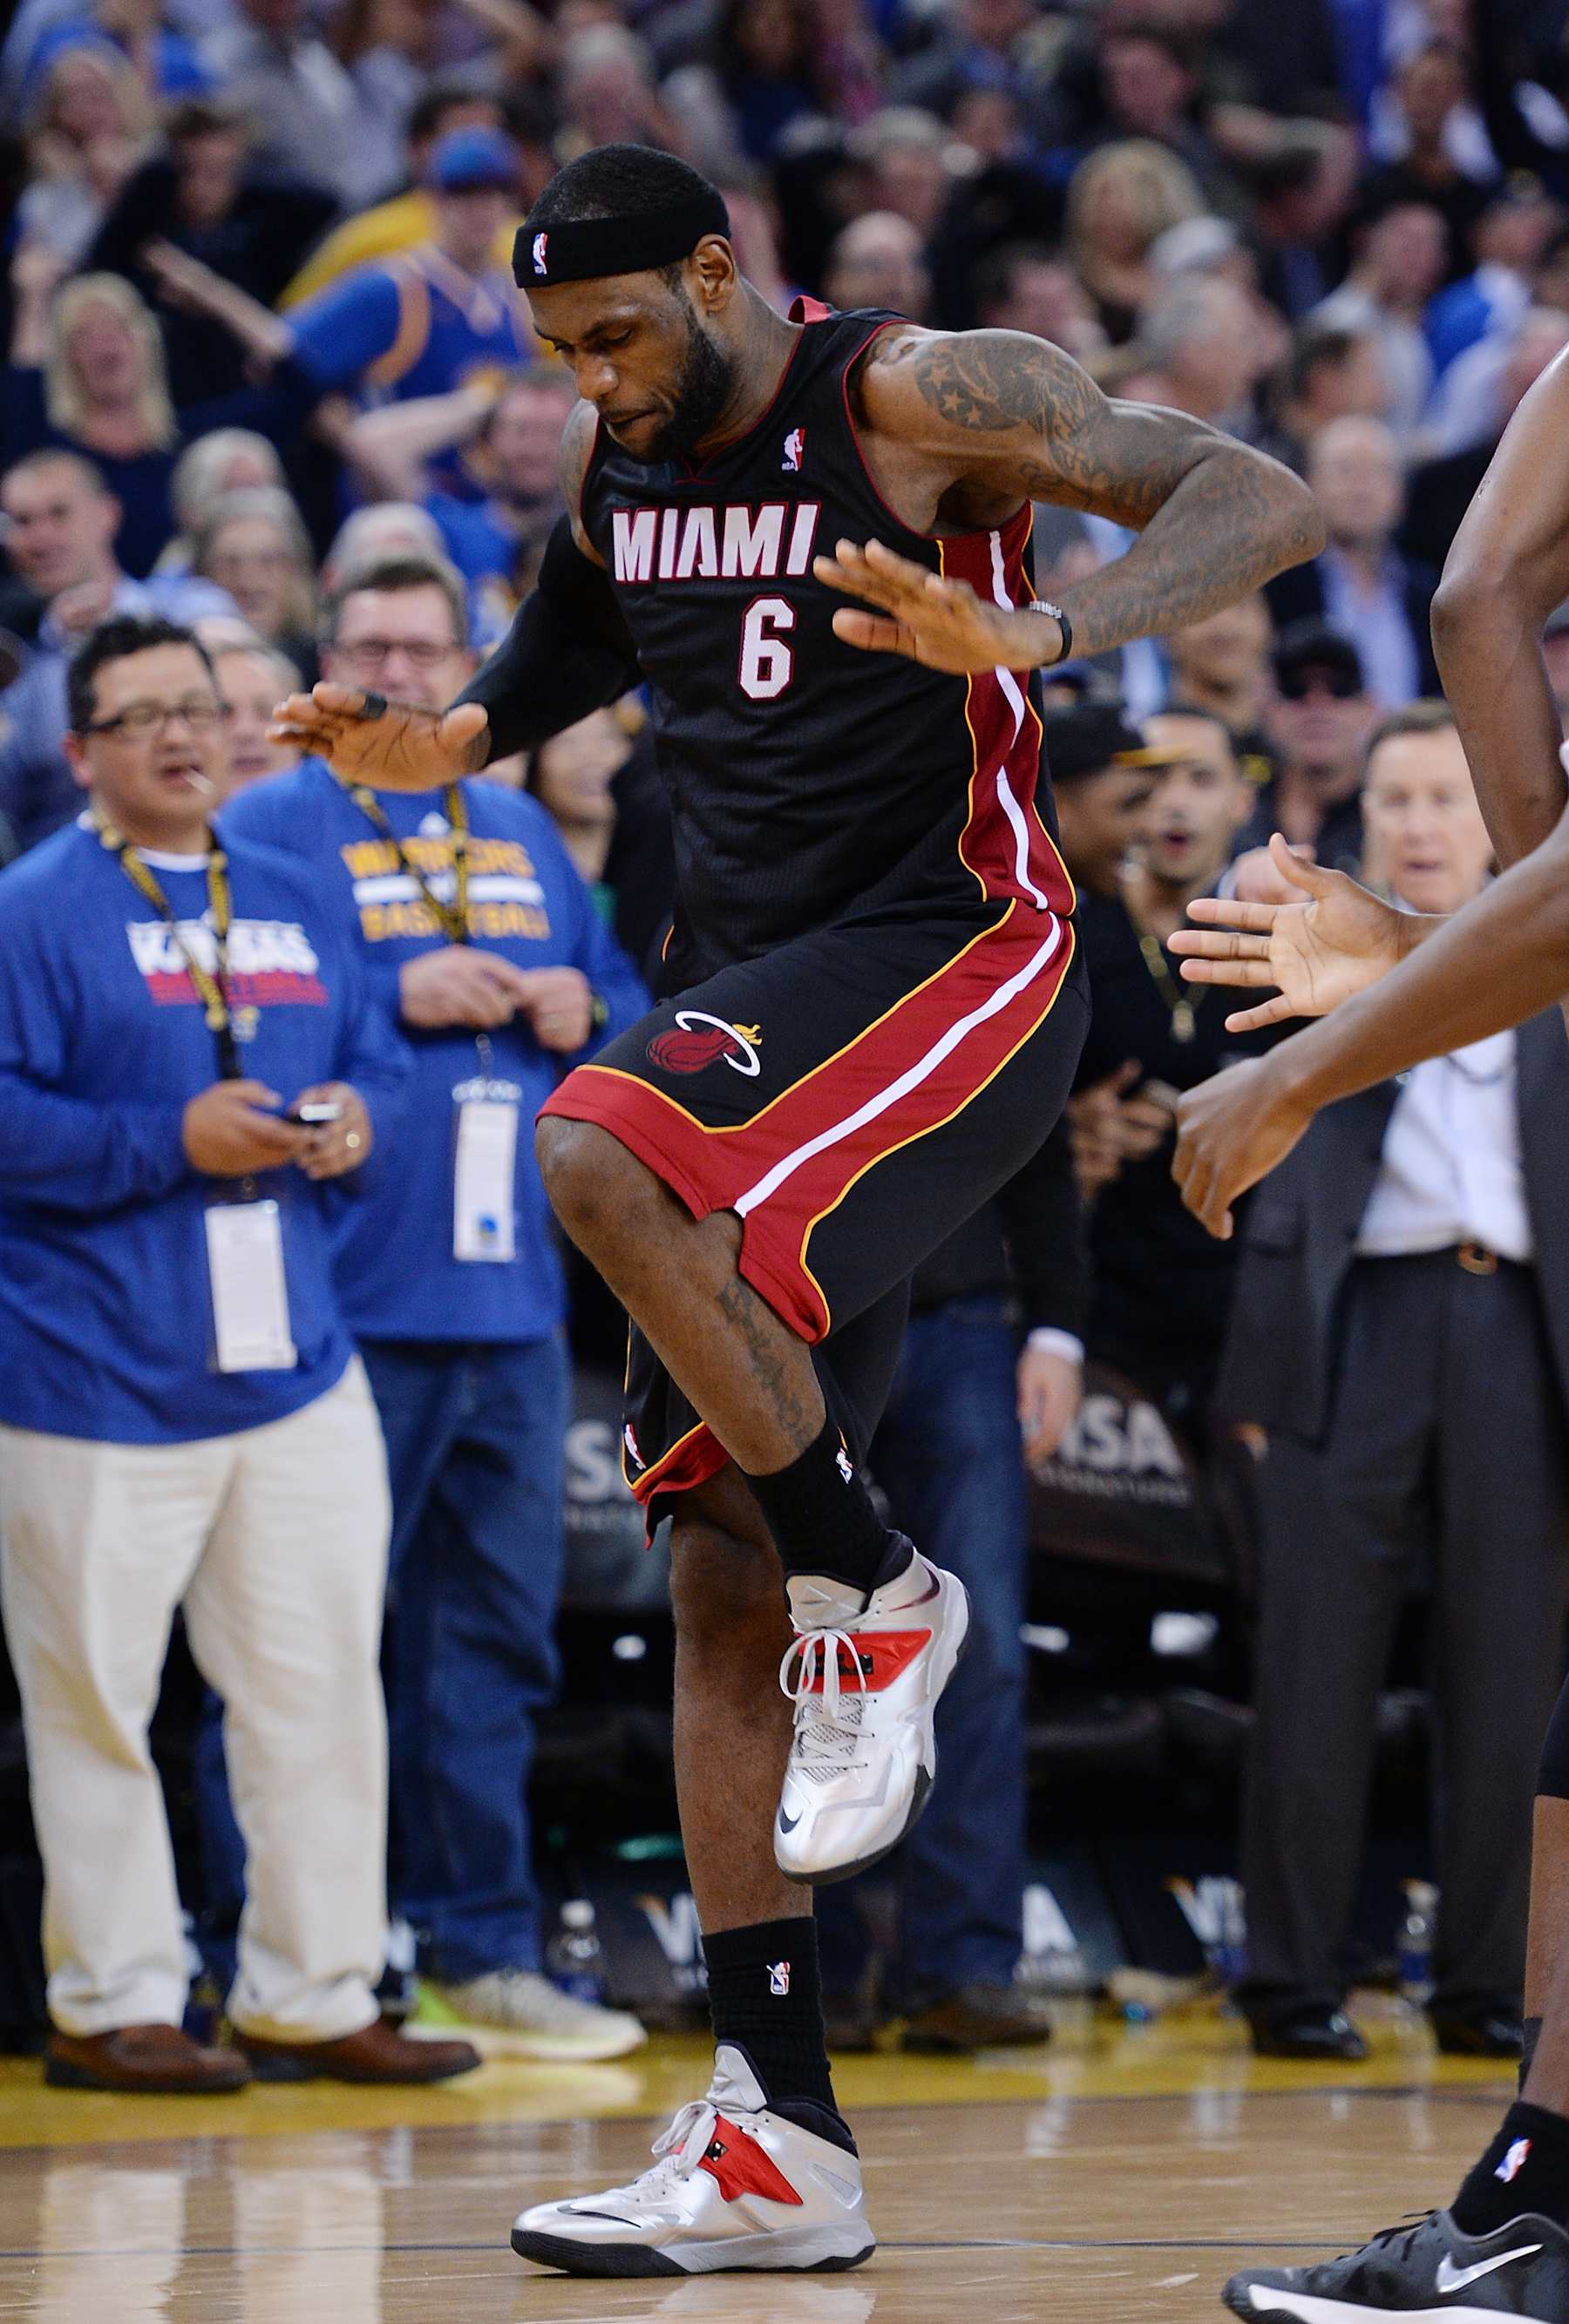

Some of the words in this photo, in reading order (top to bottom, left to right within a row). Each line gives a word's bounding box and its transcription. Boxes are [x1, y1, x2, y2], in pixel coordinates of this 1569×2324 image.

[612, 501, 821, 586] MIAMI
[739, 594, 797, 702] 6
[1023, 1394, 1185, 1476] ISA
